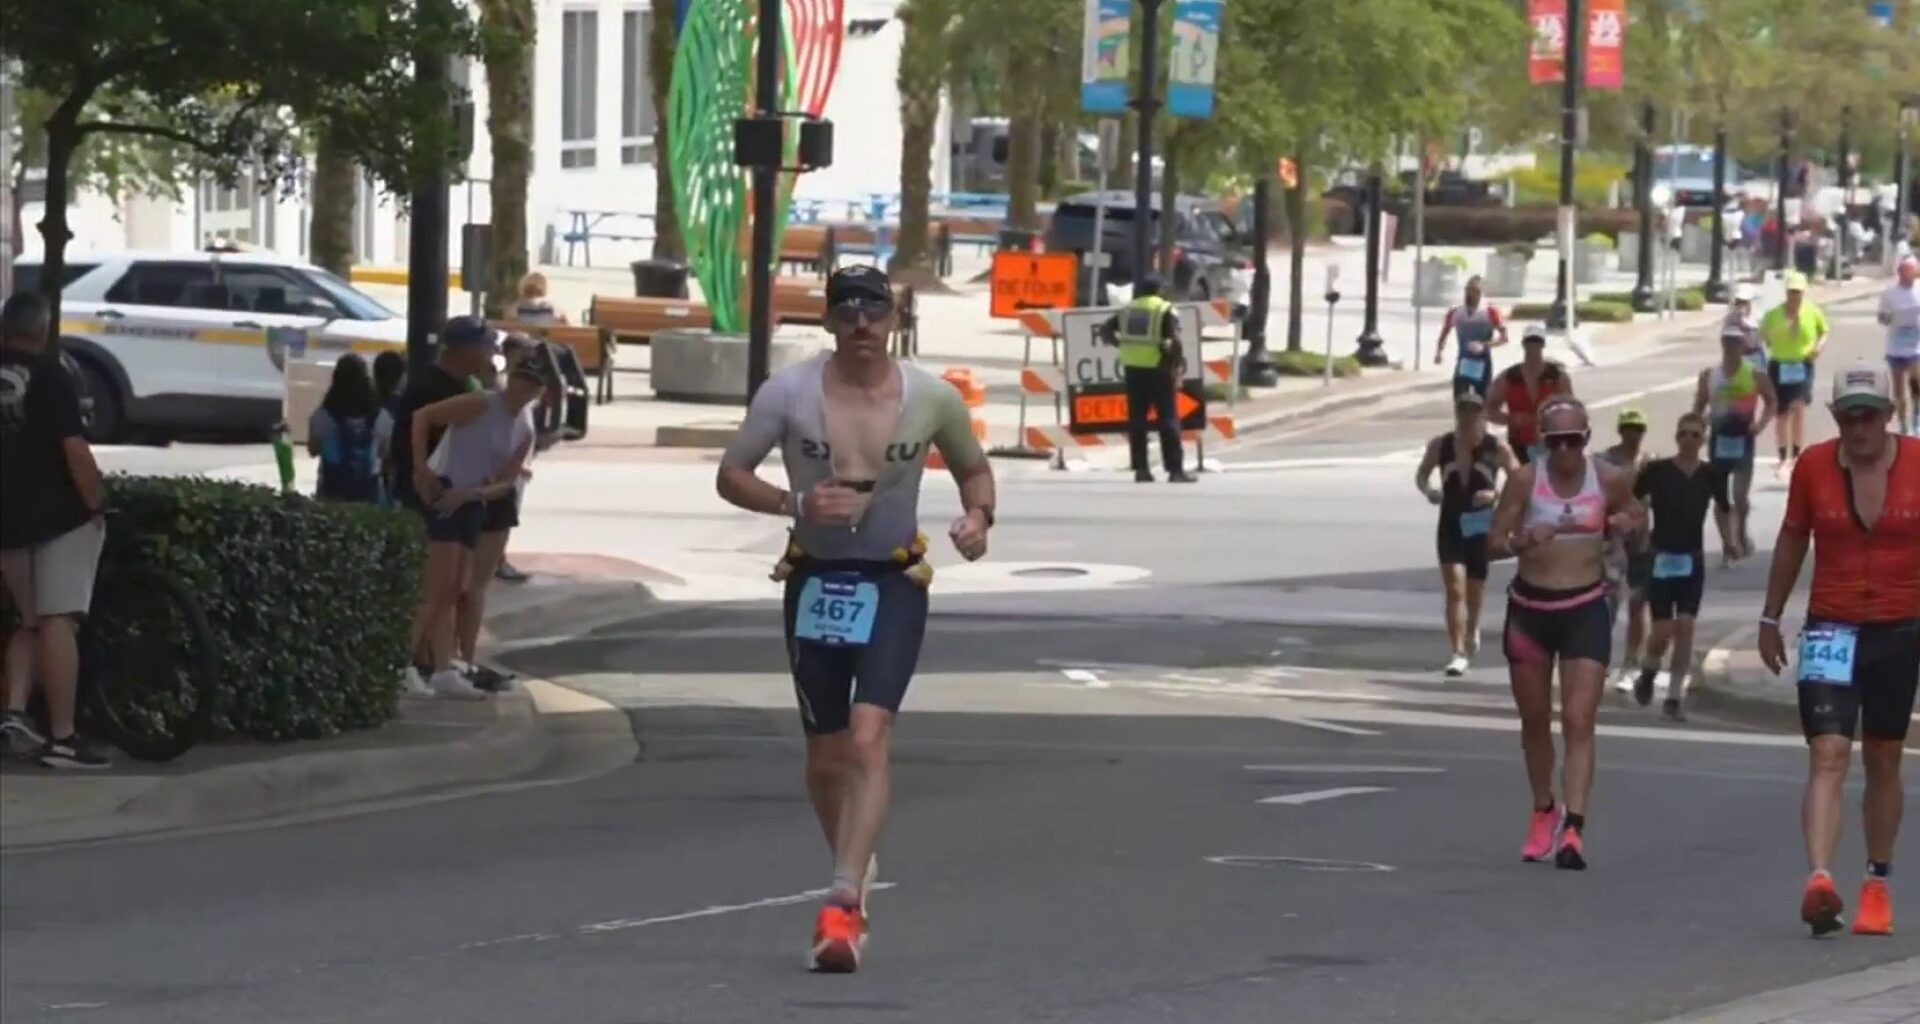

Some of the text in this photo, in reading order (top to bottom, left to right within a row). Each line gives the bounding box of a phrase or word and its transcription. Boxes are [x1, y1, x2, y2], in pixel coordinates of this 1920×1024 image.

[997, 279, 1066, 296] DETOUR
[809, 597, 865, 622] 467
[1804, 644, 1849, 664] 444
